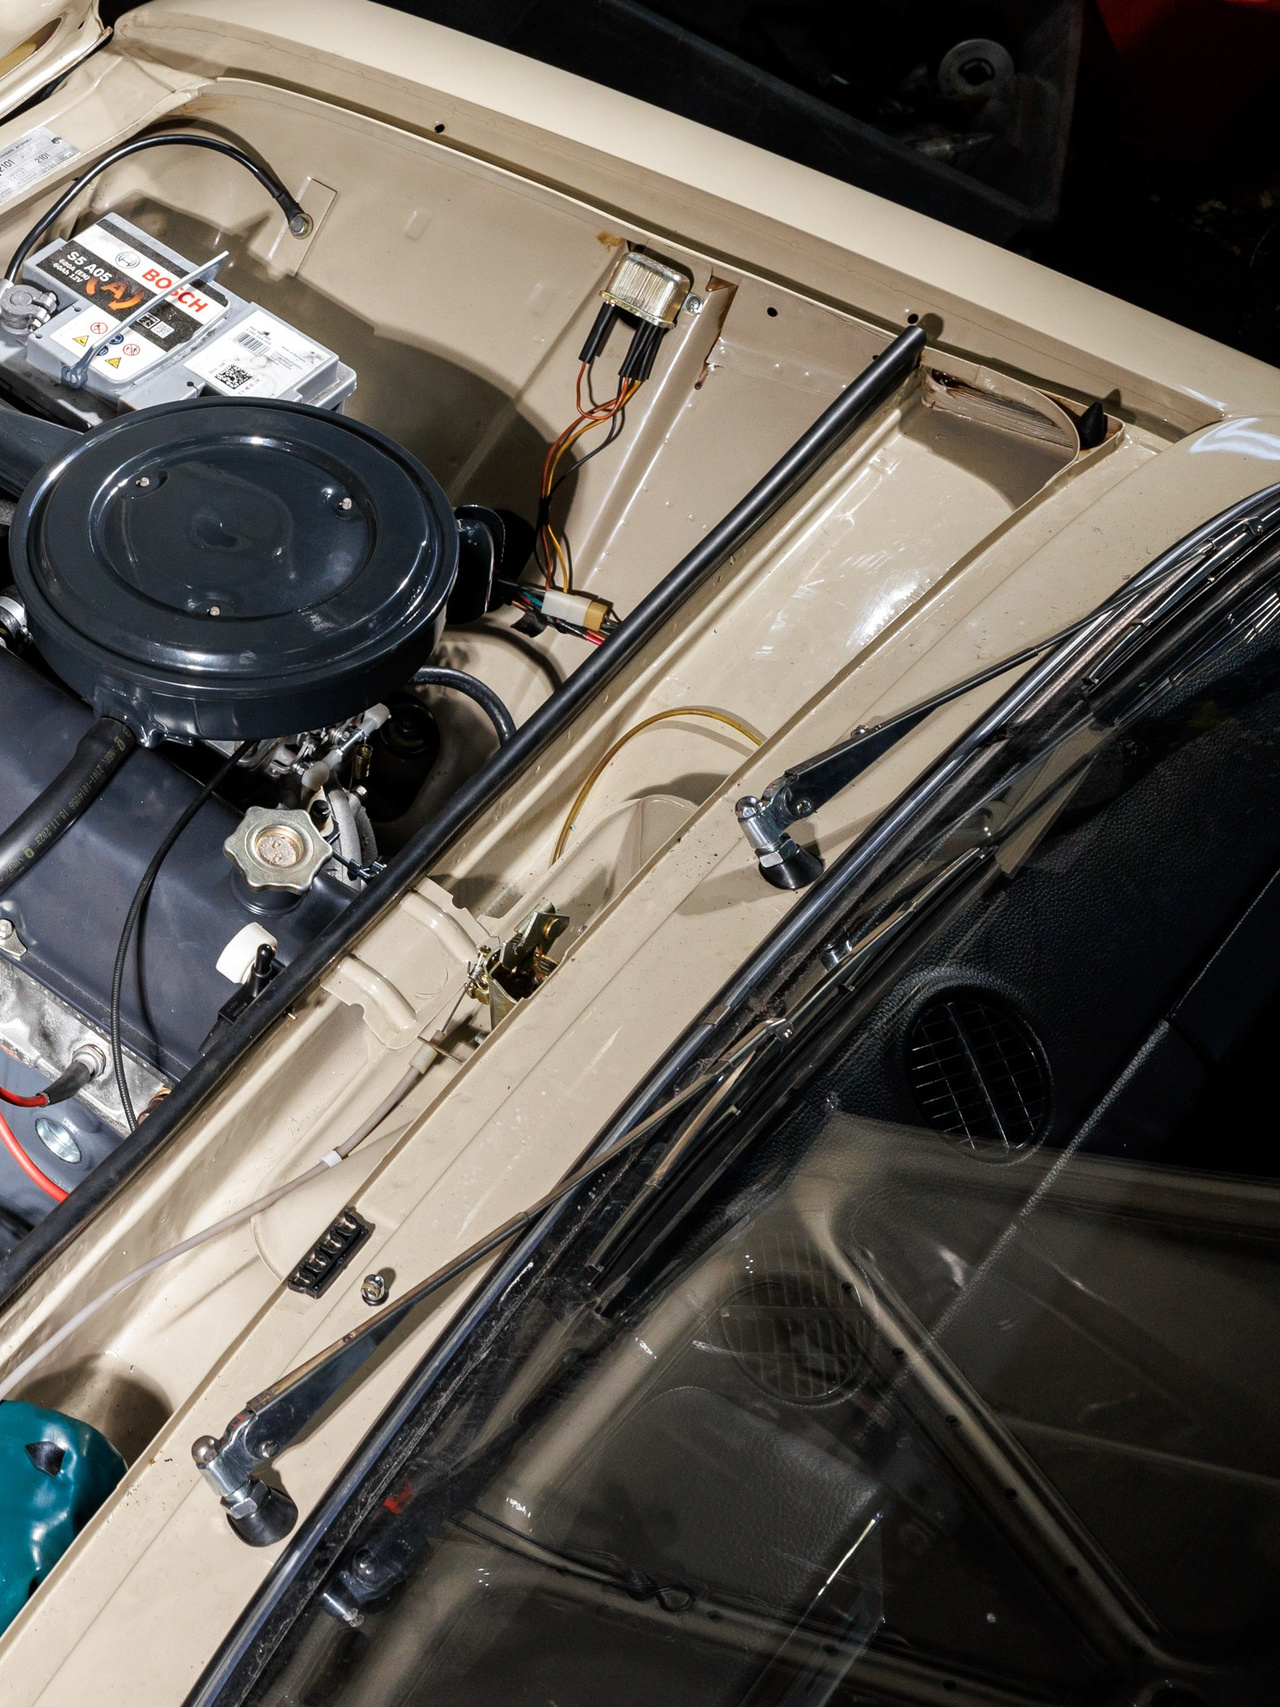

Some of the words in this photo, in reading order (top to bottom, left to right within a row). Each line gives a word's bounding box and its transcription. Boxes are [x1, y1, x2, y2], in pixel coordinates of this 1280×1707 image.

[34, 152, 51, 164] 2101
[52, 263, 70, 276] 60Ah
[69, 273, 84, 283] 12V
[66, 251, 87, 266] S5
[84, 263, 113, 282] A05
[68, 764, 105, 810] 2101-1014056
